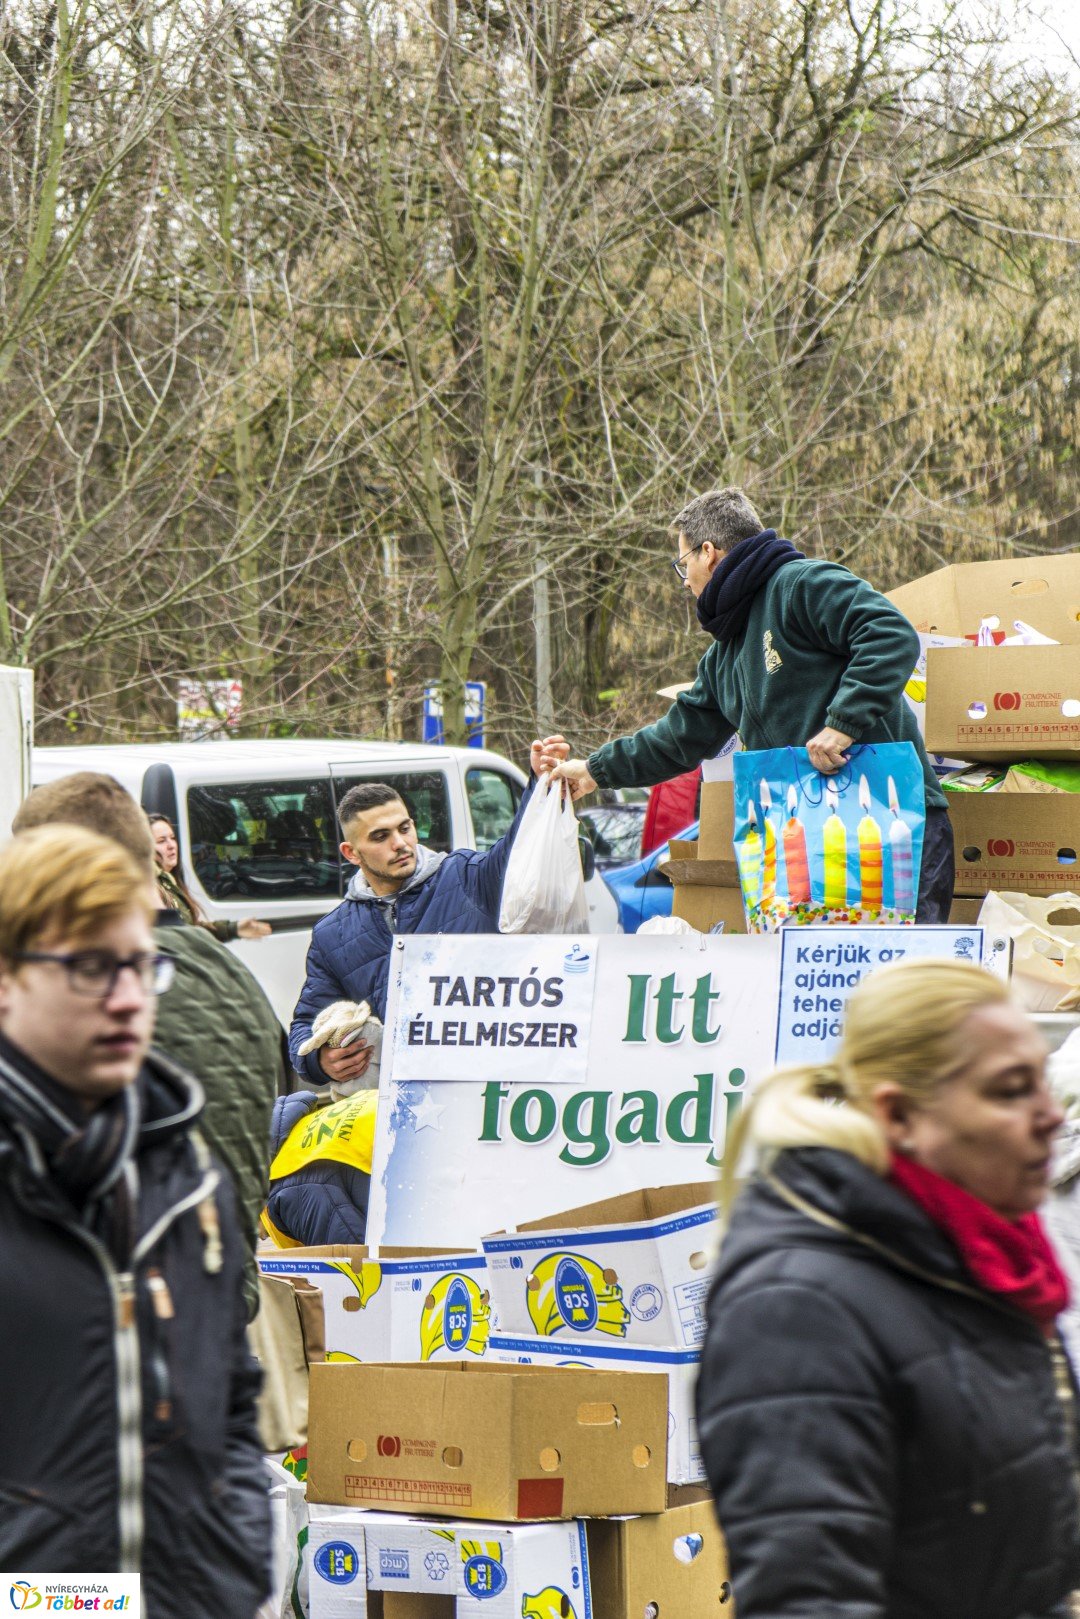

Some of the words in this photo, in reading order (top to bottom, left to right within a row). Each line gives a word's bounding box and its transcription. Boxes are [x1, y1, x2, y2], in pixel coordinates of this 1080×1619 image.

[796, 944, 871, 967] Kérjük
[878, 948, 906, 963] az
[429, 967, 564, 1008] TARTÓS
[794, 969, 866, 992] ajánd
[622, 971, 722, 1044] Itt
[407, 1013, 578, 1048] ÉLELMISZER
[791, 1019, 843, 1040] adjá
[478, 1068, 746, 1166] fogadj
[564, 1293, 589, 1308] SCB
[449, 1313, 467, 1329] SCB
[335, 1549, 345, 1576] SCB
[477, 1563, 487, 1590] SCB
